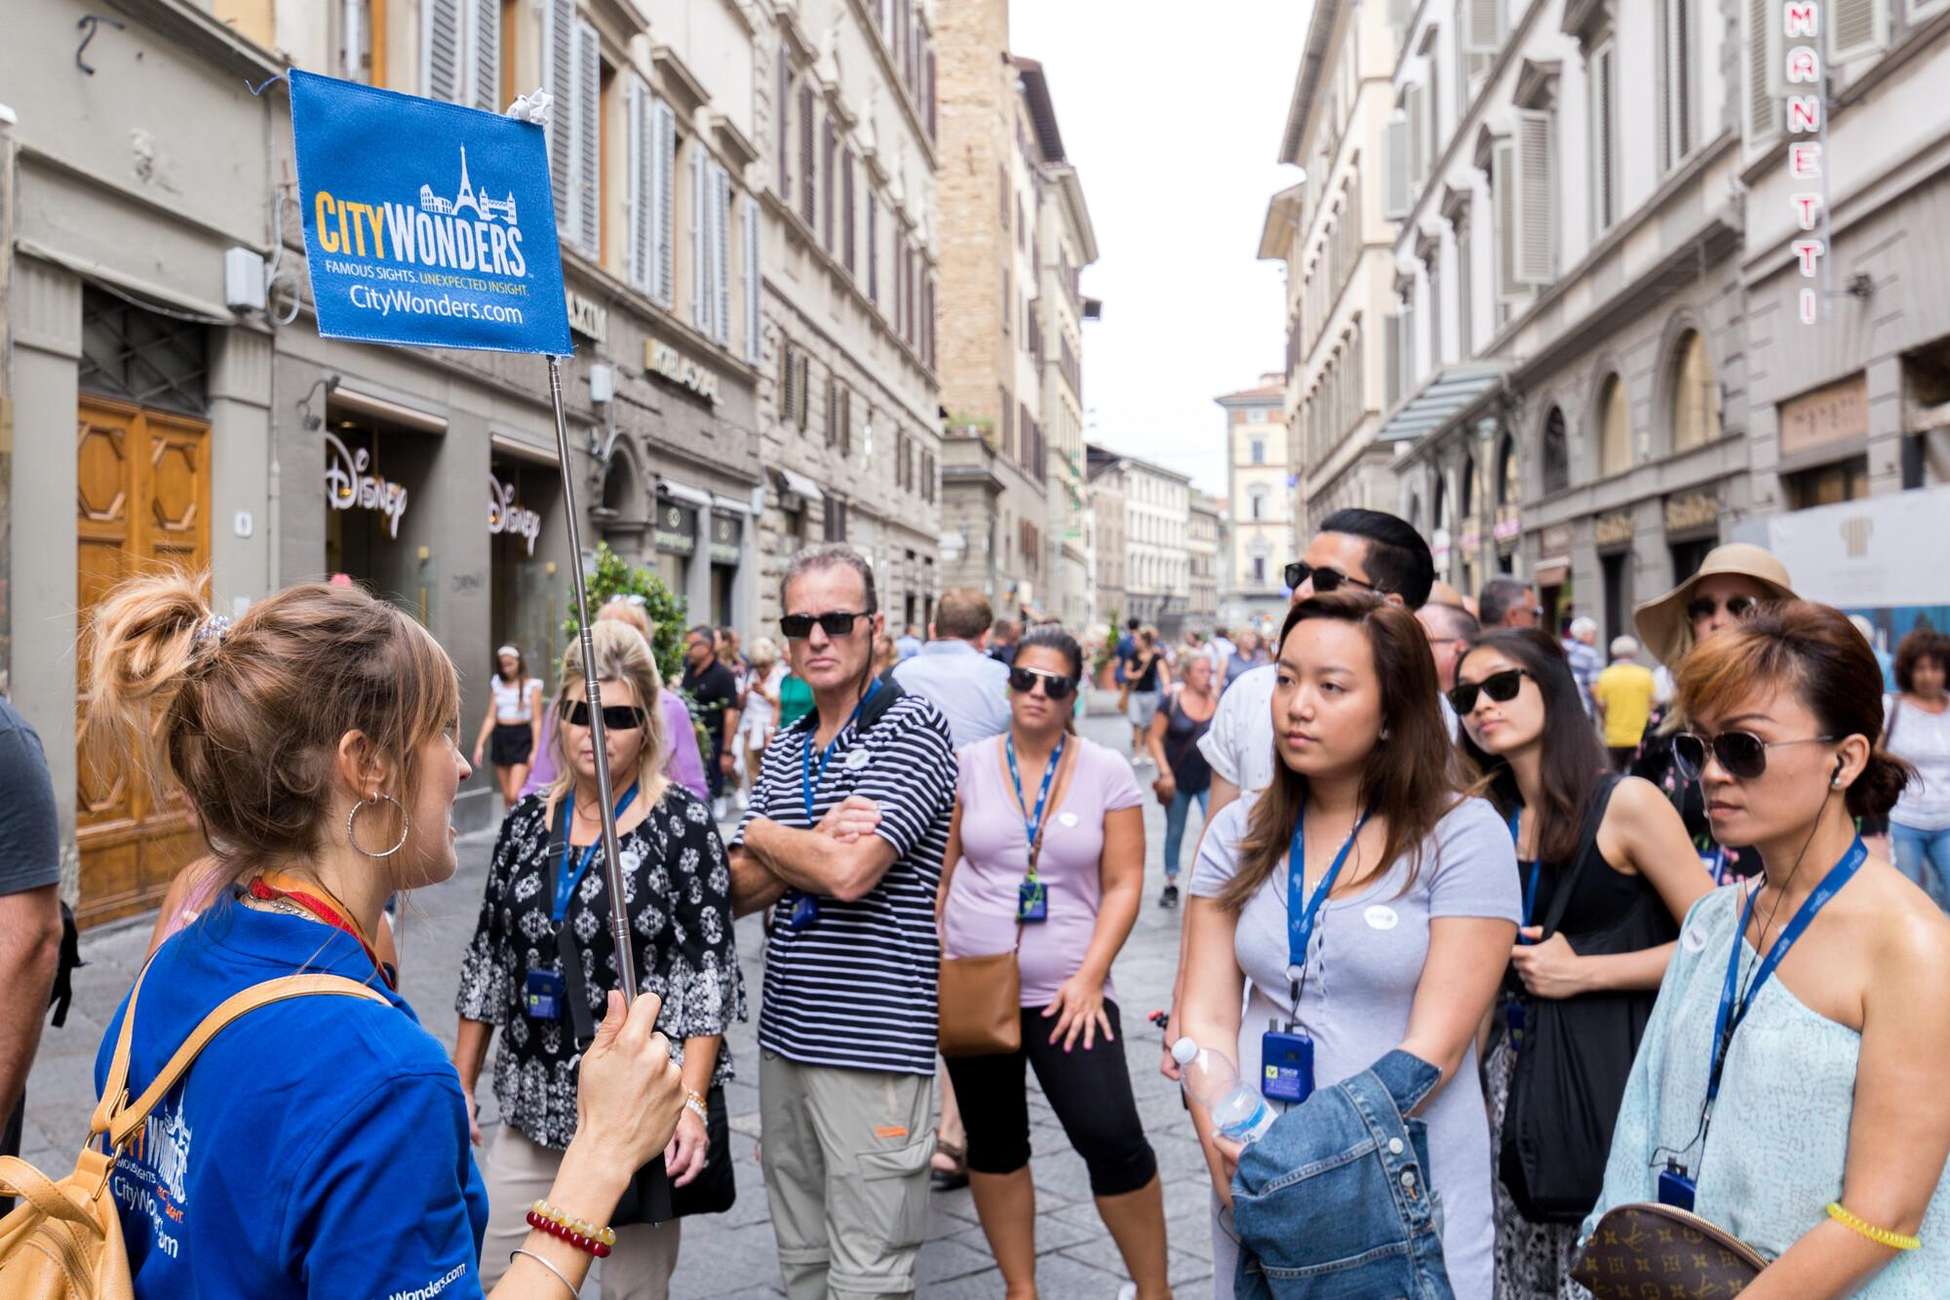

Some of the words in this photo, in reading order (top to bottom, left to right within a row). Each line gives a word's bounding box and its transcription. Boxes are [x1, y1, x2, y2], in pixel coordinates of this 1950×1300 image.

[325, 260, 375, 278] FAMOUS
[376, 266, 418, 284] SIGHTS.
[420, 271, 487, 291] UNEXPECTED
[488, 281, 530, 296] INSIGHT.
[350, 284, 523, 324] CityWonders.com
